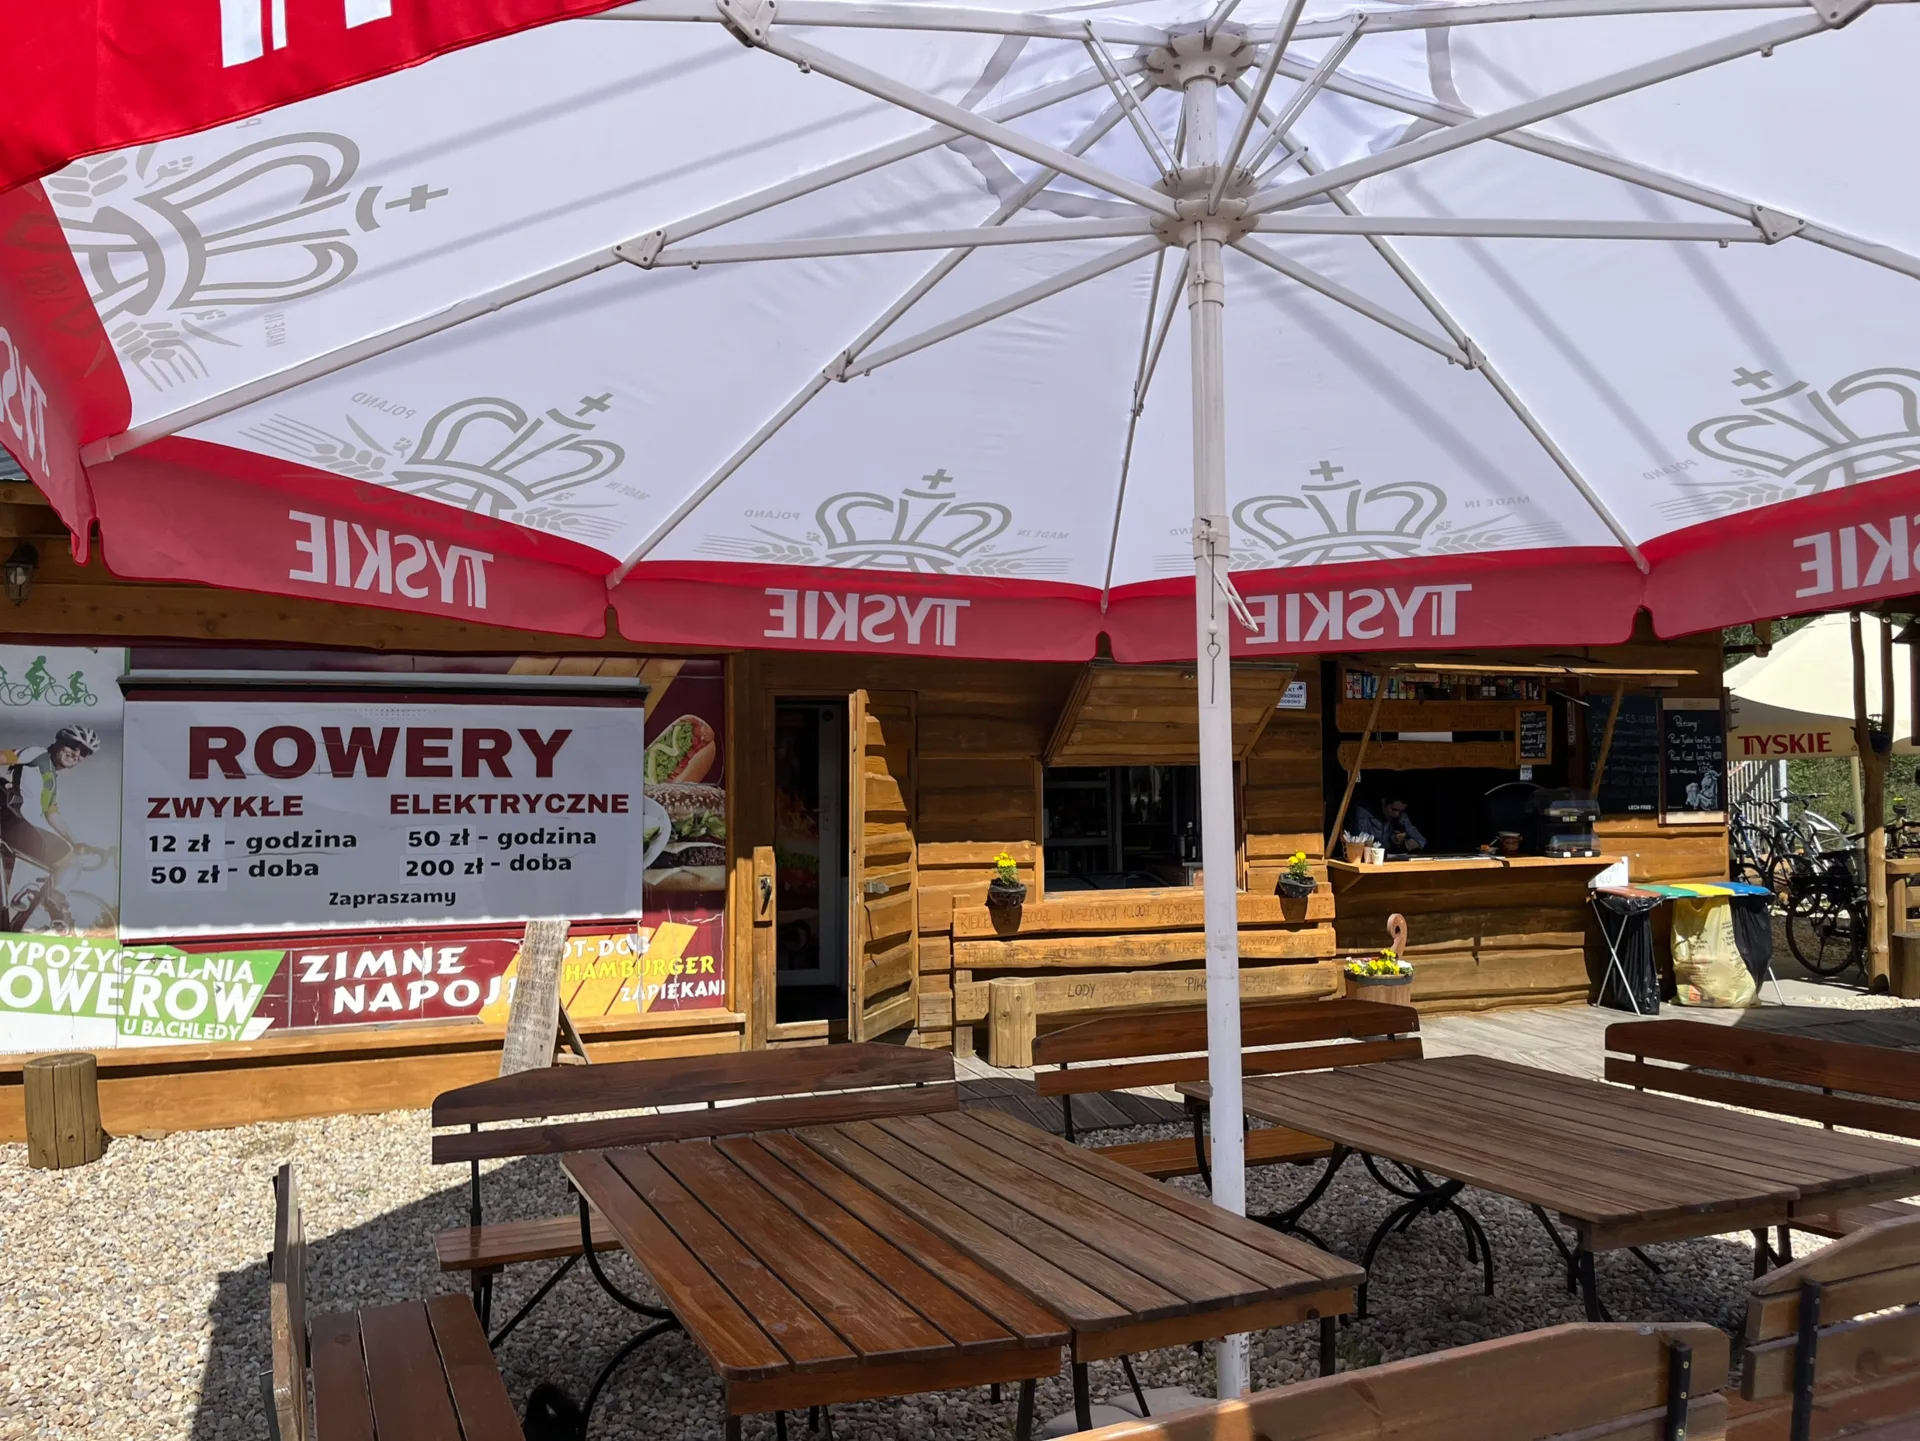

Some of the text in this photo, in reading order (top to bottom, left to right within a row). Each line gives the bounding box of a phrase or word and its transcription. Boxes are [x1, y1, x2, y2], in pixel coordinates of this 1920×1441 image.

[188, 725, 574, 780] ROWERY
[1737, 732, 1833, 756] TYSKIE
[147, 795, 304, 819] ZWYKŁE
[390, 793, 629, 815] ELEKTRYCZNE
[149, 835, 177, 853] 12
[187, 834, 211, 853] zł
[246, 829, 357, 854] godzina
[408, 830, 441, 848] 50
[449, 828, 470, 847] zł
[497, 827, 597, 850] godzina
[151, 866, 187, 885] 50
[197, 865, 221, 884] zł
[248, 859, 319, 878] doba
[405, 859, 455, 877] 200
[464, 857, 484, 875] zł
[509, 853, 572, 872] doba
[328, 890, 457, 908] Zapraszamy
[1060, 906, 1118, 924] KASZANKA
[562, 935, 651, 959] OT-DOG
[0, 939, 255, 983] YPOŻYCZALNIA
[299, 946, 468, 983] ZIMNE
[564, 955, 715, 982] HAMBURGER
[0, 965, 263, 1024] OWERÓW
[1067, 983, 1096, 999] LODY
[123, 1019, 242, 1041] U BACHLEDY
